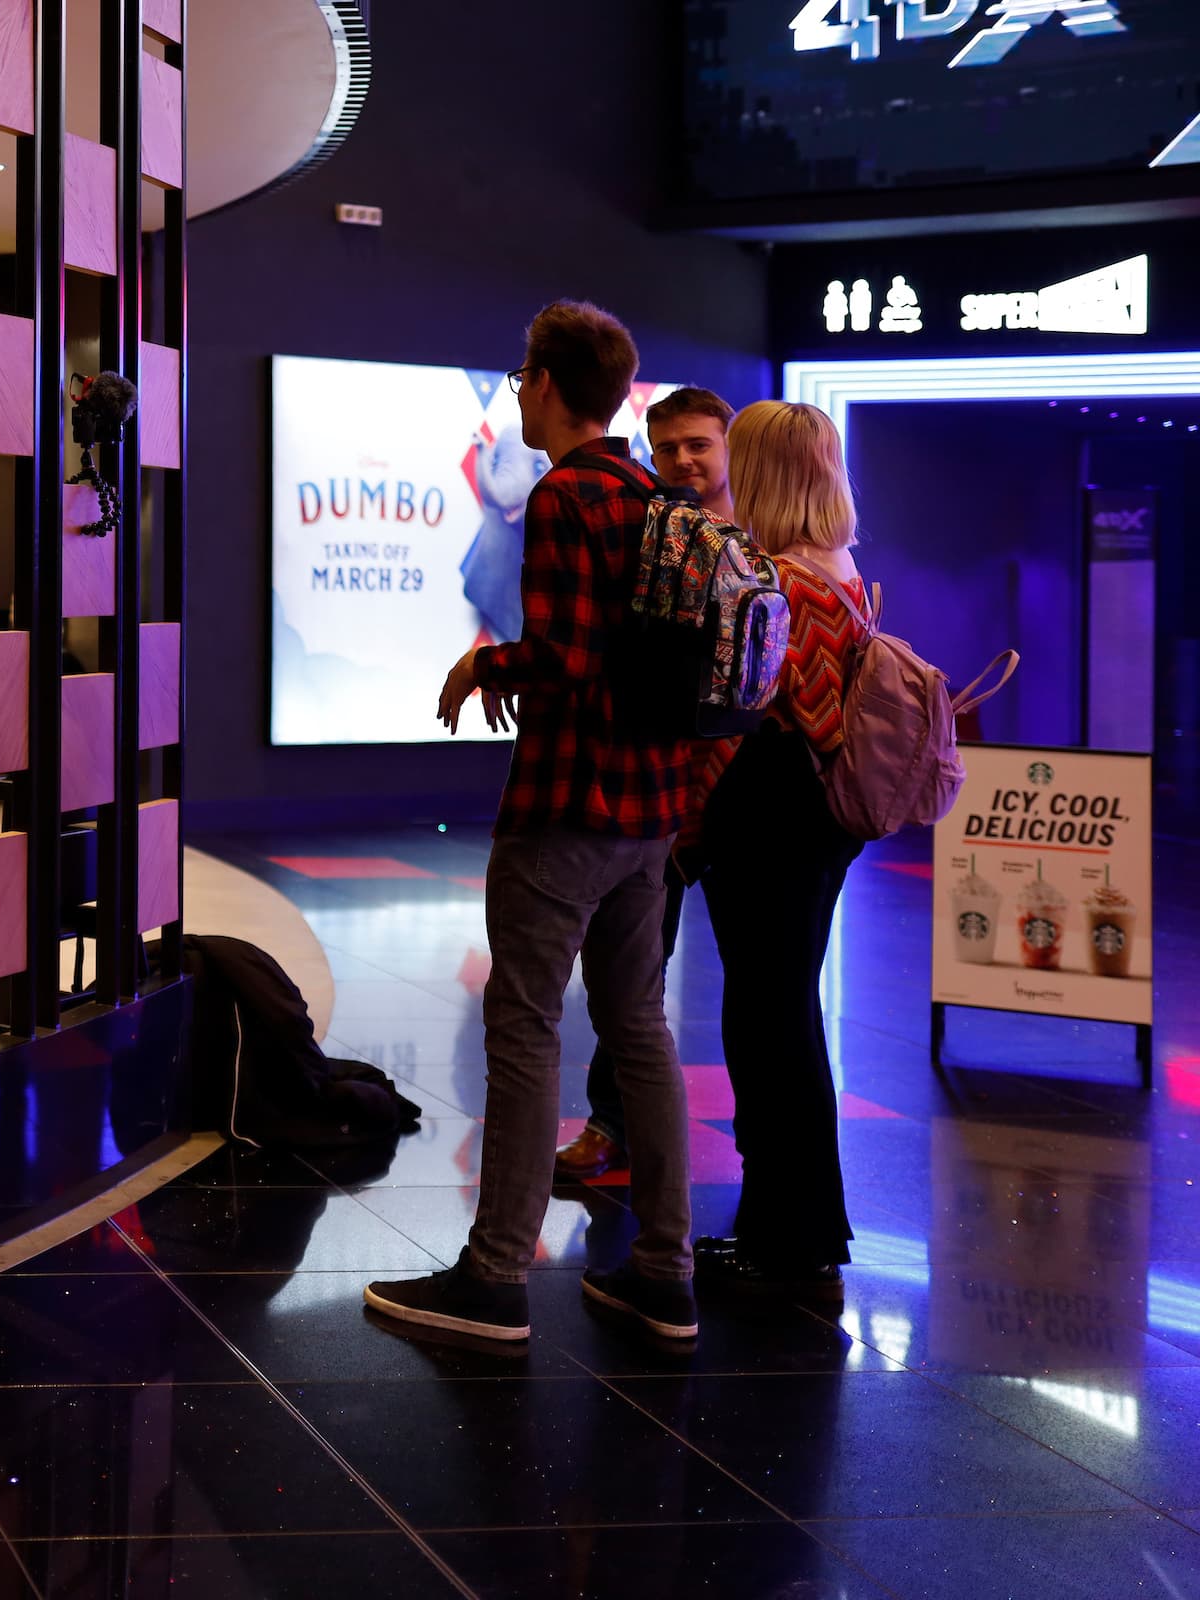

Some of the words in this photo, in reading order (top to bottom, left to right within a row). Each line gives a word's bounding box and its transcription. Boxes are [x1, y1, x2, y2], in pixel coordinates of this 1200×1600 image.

[298, 478, 444, 527] DUMBO
[323, 543, 377, 560] TAKING
[383, 545, 410, 561] OFF
[312, 567, 391, 592] MARCH
[400, 568, 423, 592] 29
[991, 789, 1040, 816] ICY,
[1050, 793, 1130, 823] COOL,
[964, 814, 1116, 847] DELICIOUS
